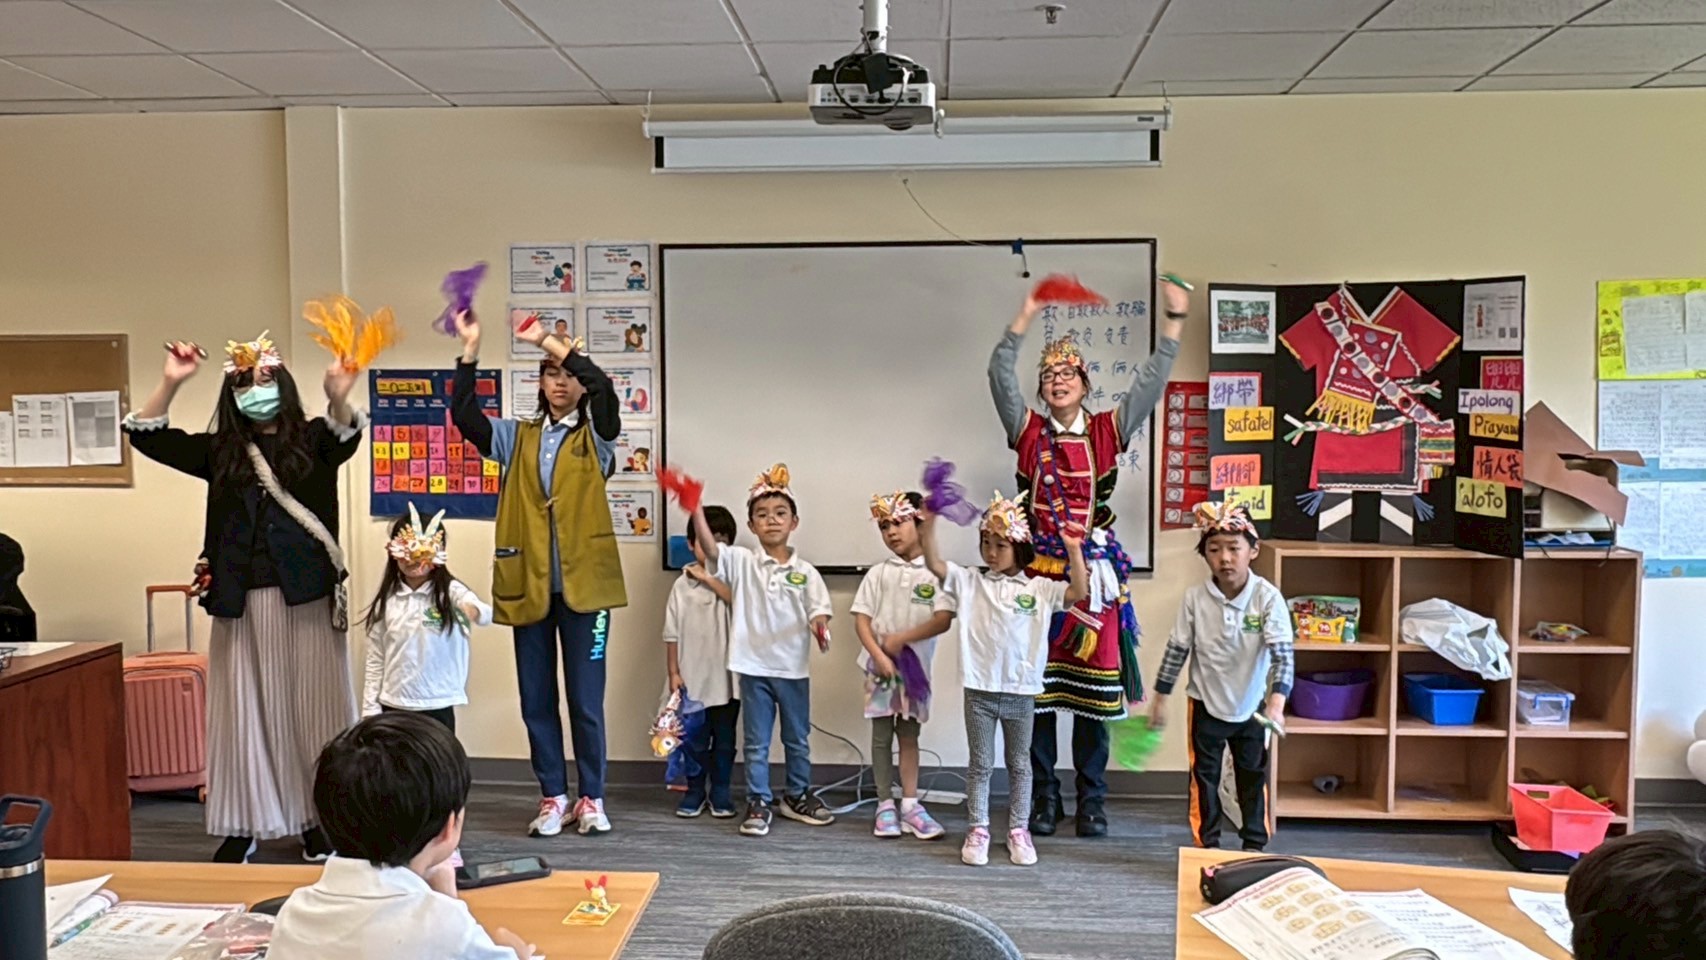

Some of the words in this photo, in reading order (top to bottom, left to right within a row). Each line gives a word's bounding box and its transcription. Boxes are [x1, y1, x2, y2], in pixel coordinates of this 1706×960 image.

[1460, 391, 1514, 413] Ipolong
[1227, 411, 1272, 433] safatel
[1477, 450, 1521, 482] 情人袋
